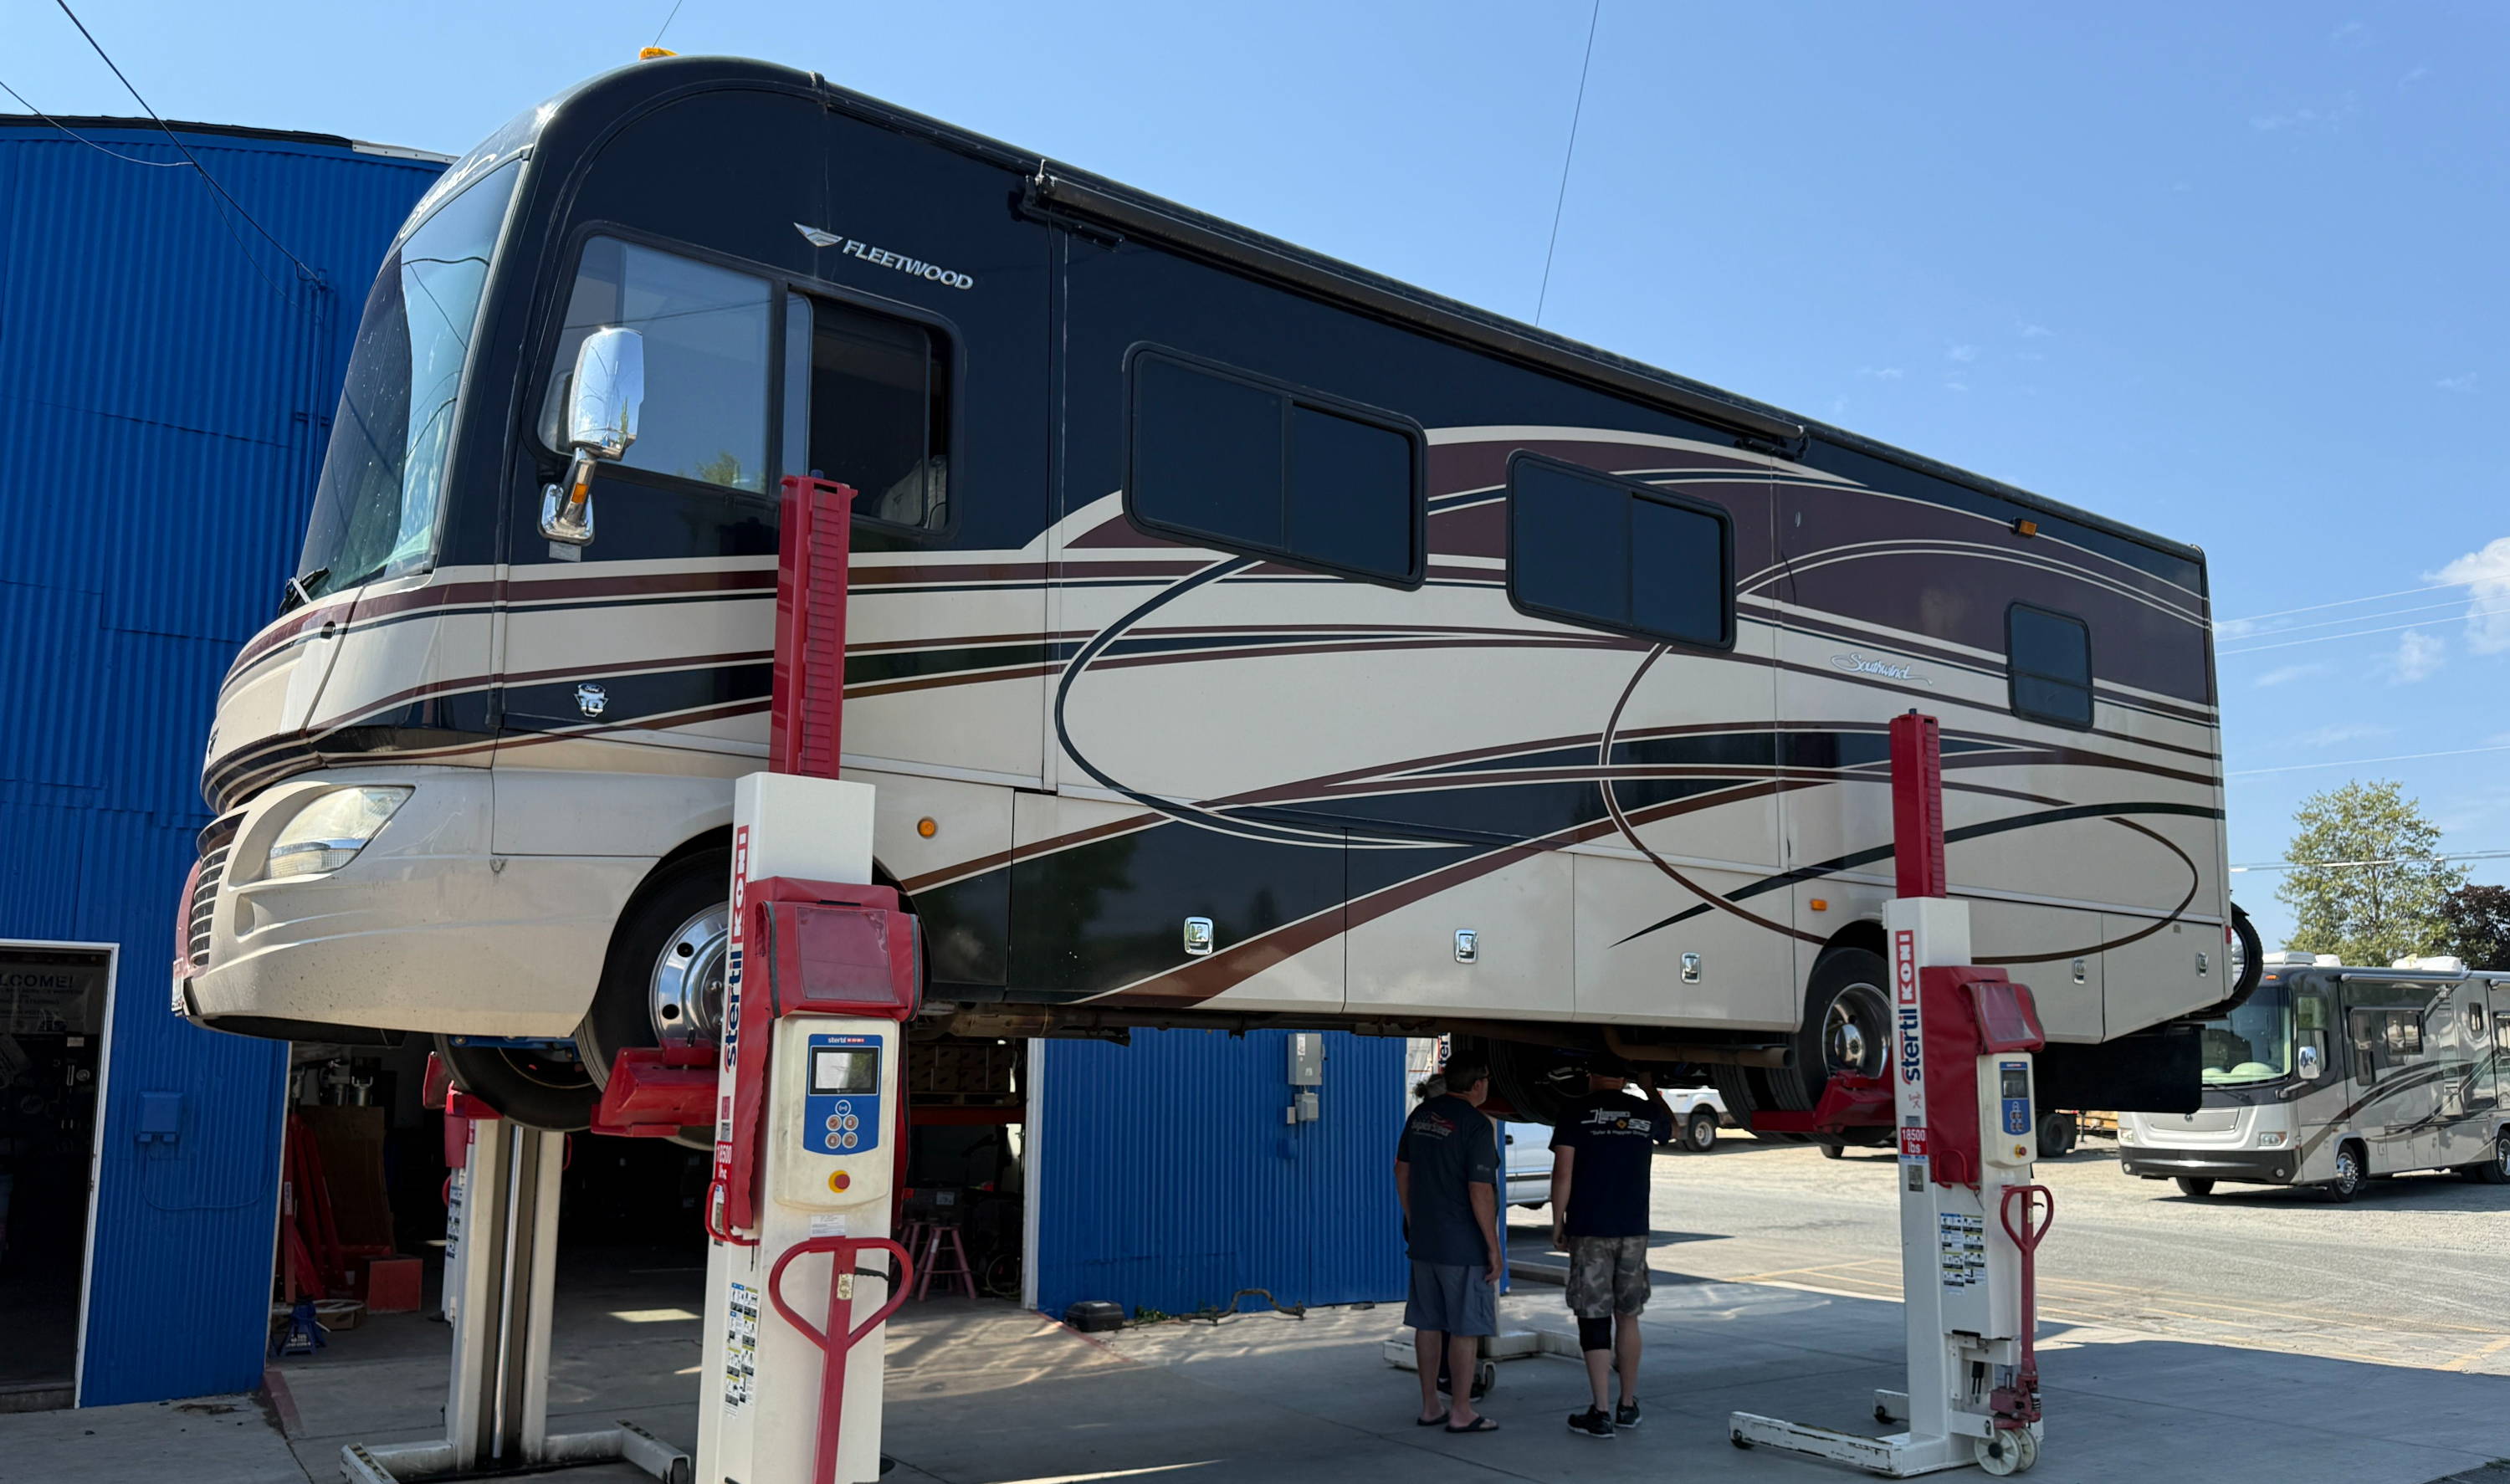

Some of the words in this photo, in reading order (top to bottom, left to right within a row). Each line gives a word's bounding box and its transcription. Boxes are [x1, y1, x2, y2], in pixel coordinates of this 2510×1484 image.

[843, 239, 973, 289] FLEETWOOD
[1830, 652, 1933, 685] Southwind
[725, 950, 743, 1069] stertil
[734, 832, 748, 939] KONI
[1898, 934, 1913, 1001] KONI
[1898, 1008, 1920, 1082] stertil
[1902, 1128, 1925, 1141] 18500
[1908, 1141, 1921, 1154] lbs
